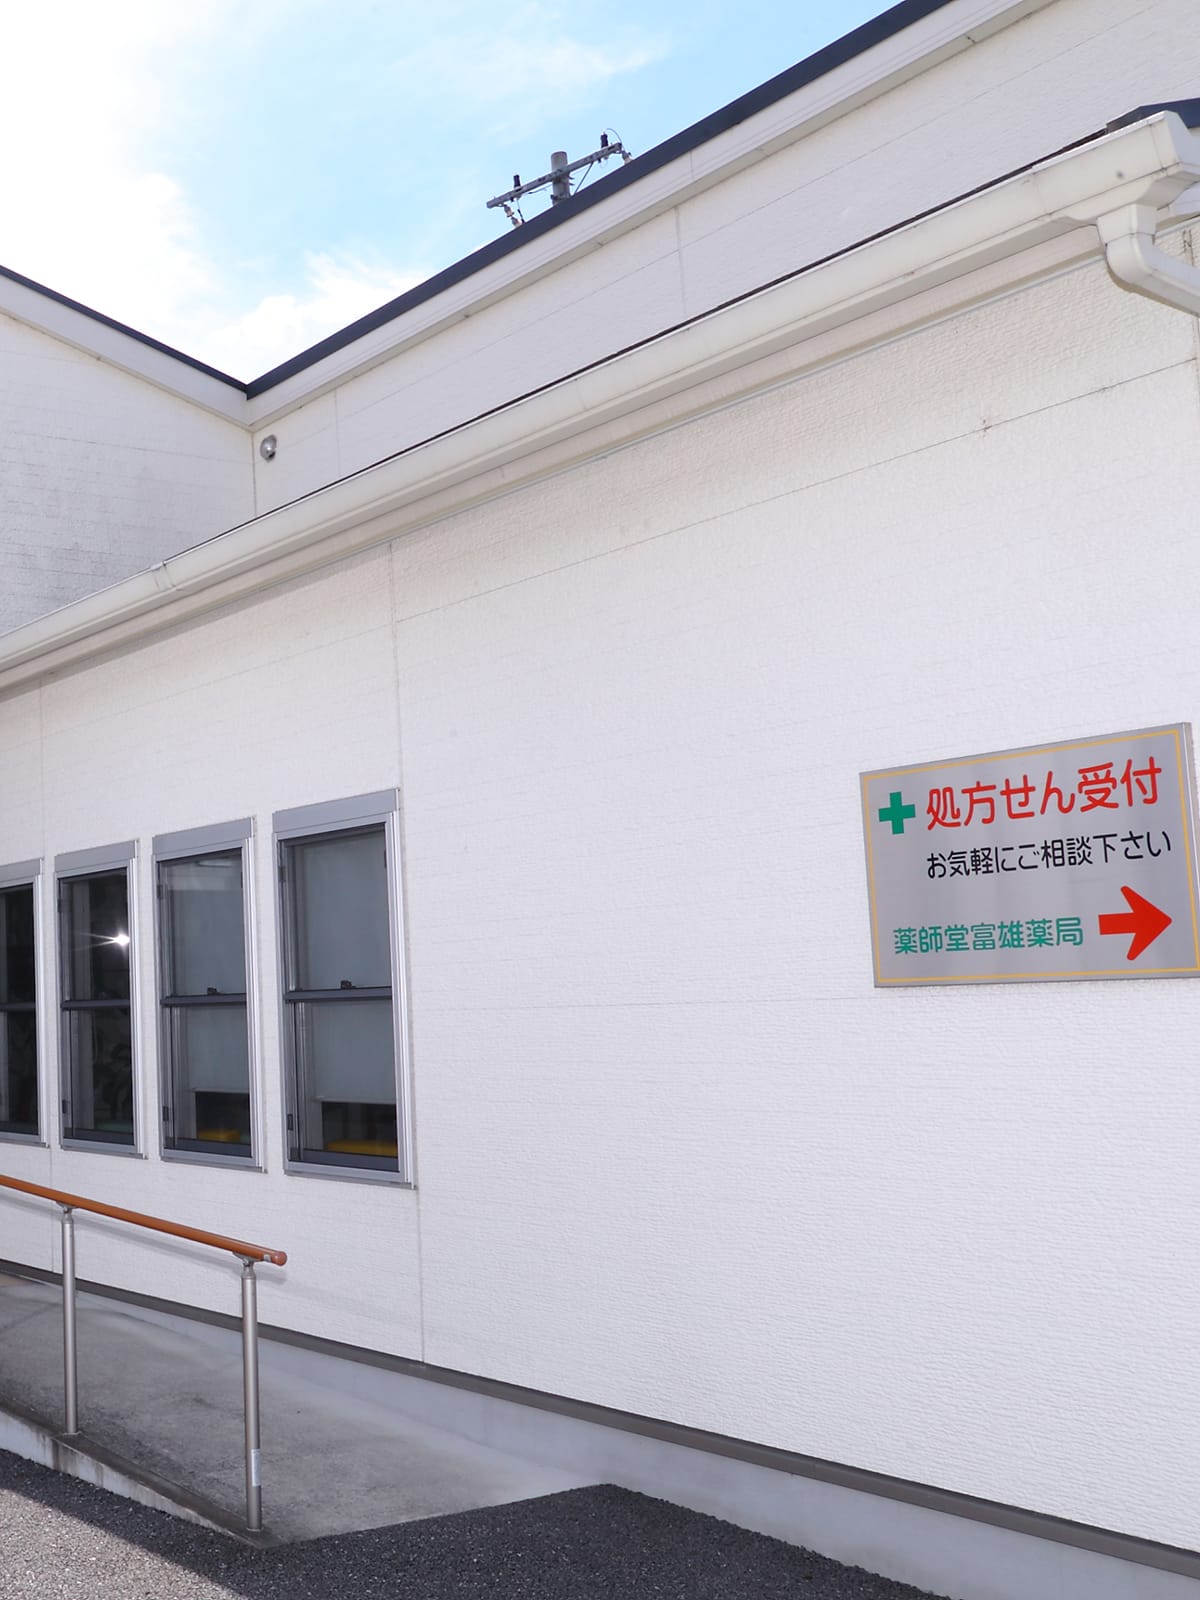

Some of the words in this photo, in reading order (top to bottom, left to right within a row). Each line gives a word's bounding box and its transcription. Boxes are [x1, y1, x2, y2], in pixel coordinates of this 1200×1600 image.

[926, 756, 1162, 830] 処方せん受付
[926, 830, 1171, 879] お気軽にご相談下さい
[893, 917, 1084, 954] 薬師堂富雄薬局
